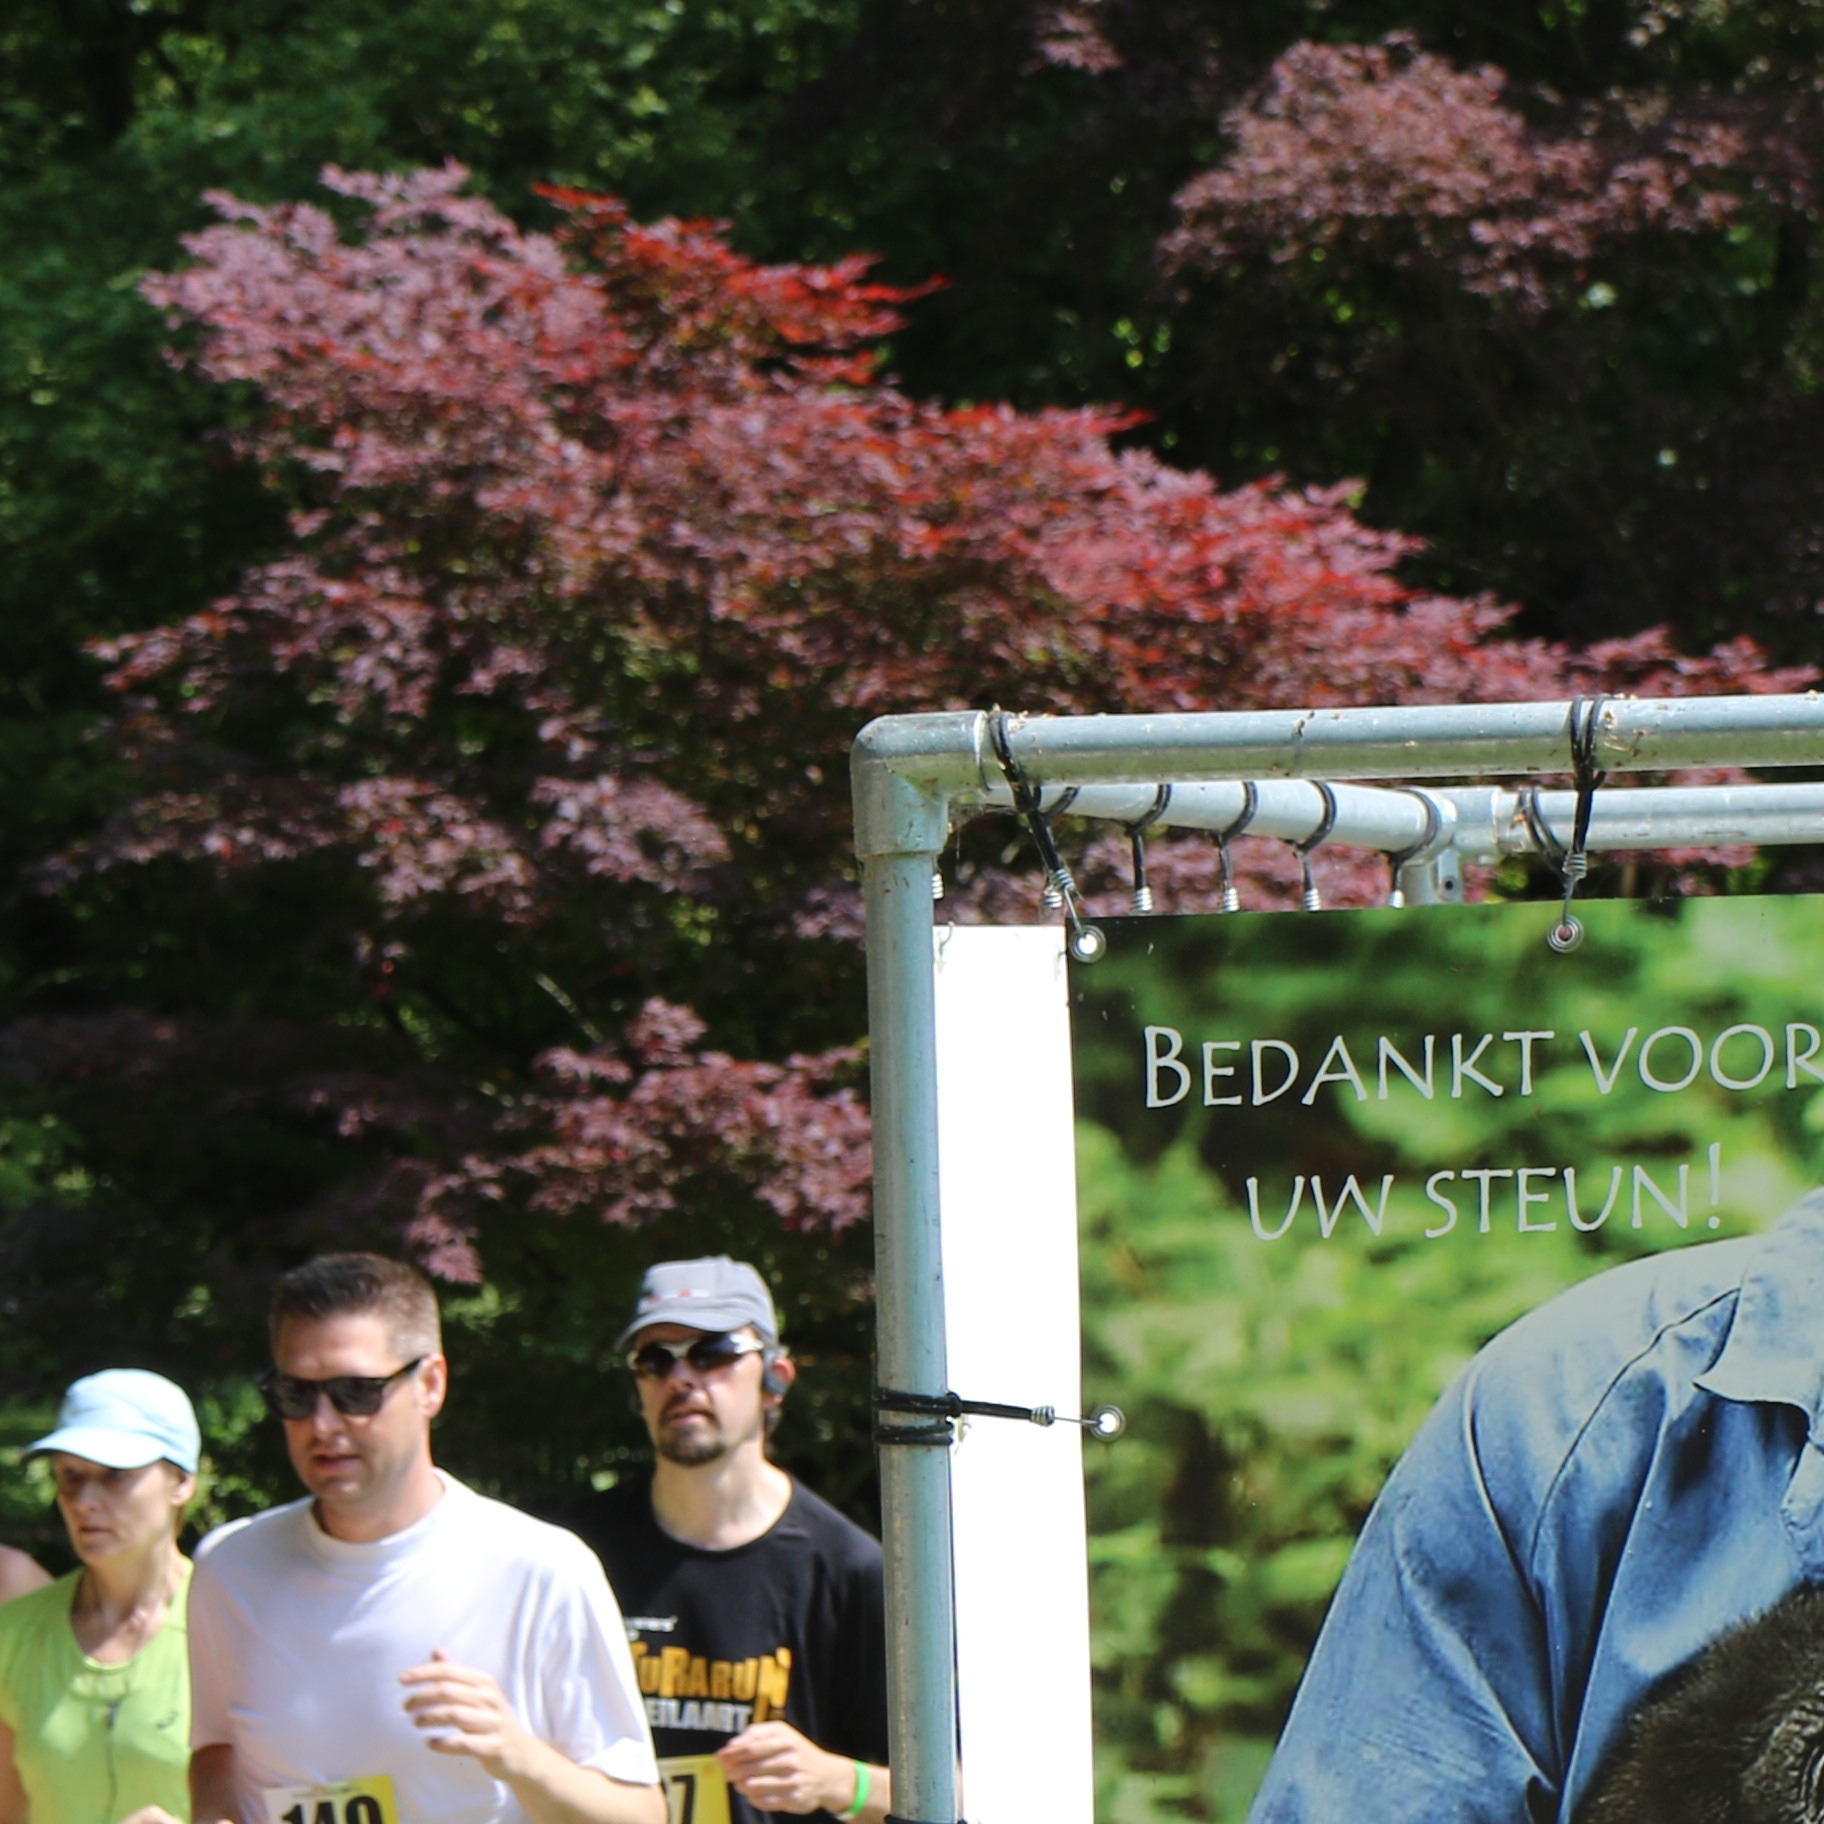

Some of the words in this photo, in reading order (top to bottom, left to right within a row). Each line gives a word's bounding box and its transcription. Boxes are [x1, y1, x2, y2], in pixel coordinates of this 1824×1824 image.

[1143, 1024, 1555, 1109] BEDANKT
[1245, 1173, 1395, 1241] UW
[1425, 1142, 1723, 1240] STEUN!
